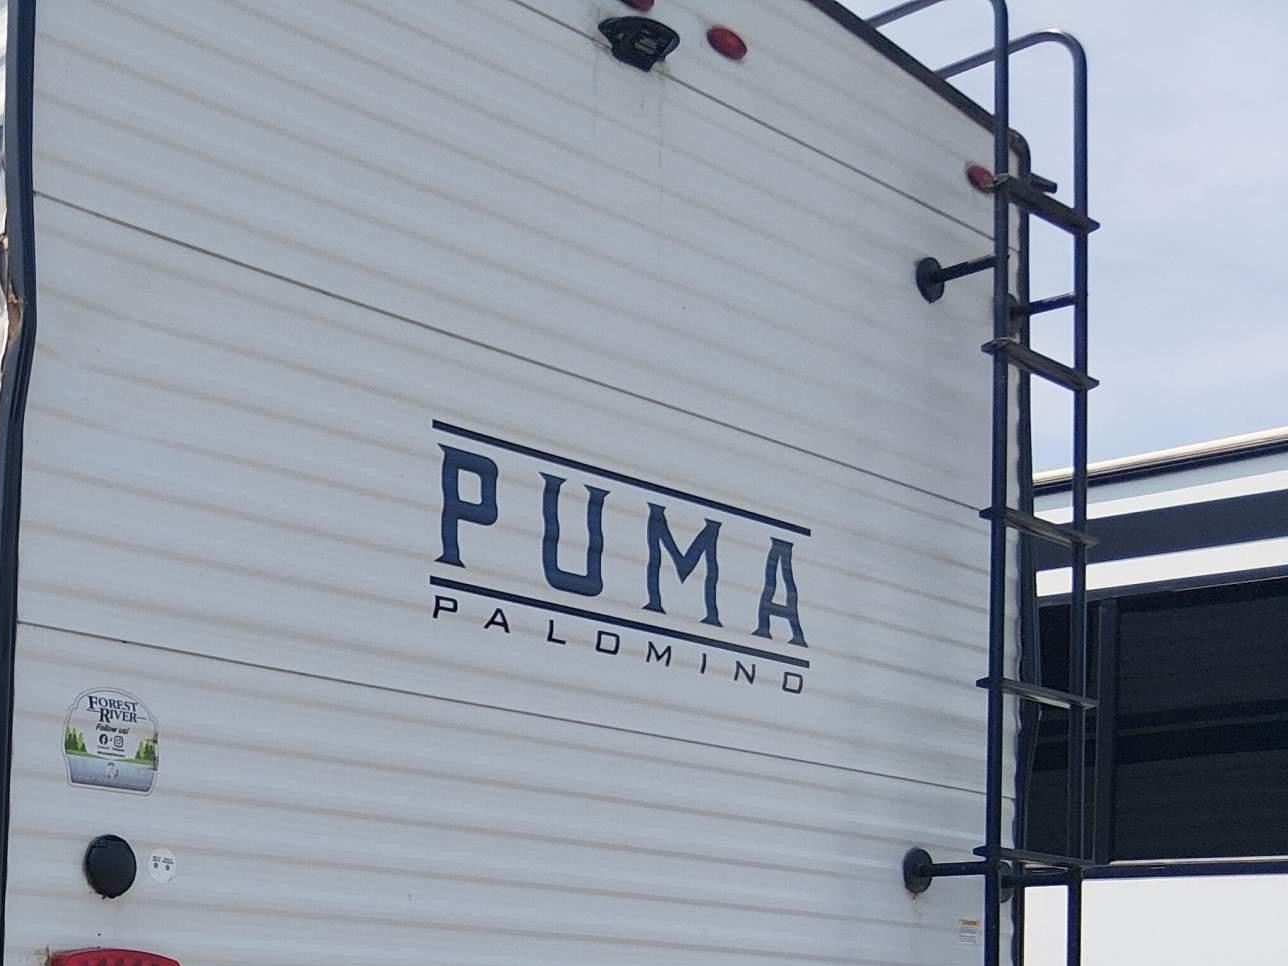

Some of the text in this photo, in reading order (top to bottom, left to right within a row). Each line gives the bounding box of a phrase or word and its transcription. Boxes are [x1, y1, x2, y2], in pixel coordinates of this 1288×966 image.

[433, 443, 808, 648] PUMA
[432, 595, 804, 695] PALOMINO
[87, 695, 138, 712] FOREST
[99, 708, 137, 723] RIVER
